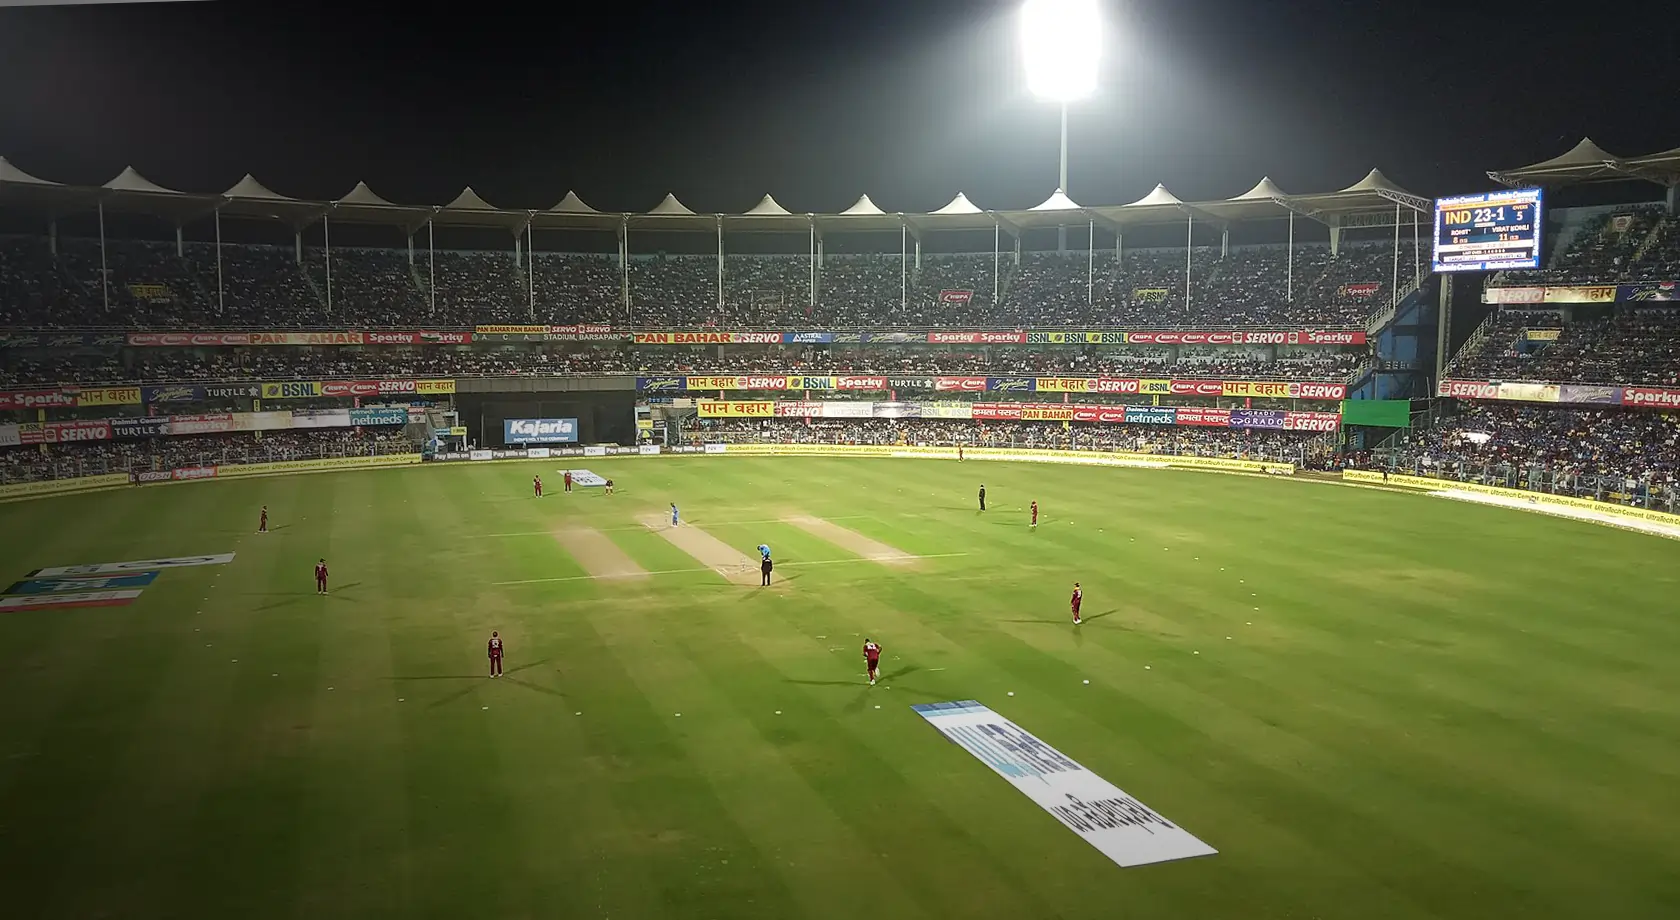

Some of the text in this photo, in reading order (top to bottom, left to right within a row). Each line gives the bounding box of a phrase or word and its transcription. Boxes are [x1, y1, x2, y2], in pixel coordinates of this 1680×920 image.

[1445, 207, 1505, 225] IND 23-1
[1516, 212, 1523, 221] 5
[249, 332, 360, 344] PAN BAHAR
[370, 333, 413, 343] Sparky
[636, 333, 731, 343] PAN BAHAR
[743, 333, 781, 342] SERVO
[935, 333, 974, 342] Sparky
[980, 333, 1020, 342] Sparky
[1028, 333, 1051, 342] BSNL
[1064, 333, 1089, 342] BSNL
[1101, 333, 1126, 343] BSNL
[1245, 333, 1284, 344] SERVO
[1308, 333, 1352, 343] Sparky
[379, 382, 415, 391] SERVO
[689, 378, 706, 388] पान
[748, 377, 785, 388] SERVO
[803, 377, 834, 389] BSNL
[838, 378, 883, 387] Sparky
[890, 379, 922, 387] TURTLE
[1038, 379, 1056, 389] पान
[1098, 381, 1138, 391] SERVO
[1149, 383, 1170, 392] BSNL
[207, 388, 244, 397] TURTLE
[282, 383, 318, 396] BSNL
[1224, 383, 1251, 394] पान
[1301, 385, 1343, 398] SERVO
[1452, 383, 1495, 397] SERVO
[80, 388, 138, 403] पान बहार
[1625, 389, 1680, 406] Sparky
[700, 402, 730, 414] पान
[783, 407, 821, 416] SERVO
[352, 413, 402, 425] netmeds
[1022, 410, 1072, 419] PAN BAHAR
[1126, 413, 1172, 424] netmeds
[510, 420, 573, 437] Kajaria
[1294, 419, 1335, 431] SERVO
[61, 427, 107, 441] SERVO
[114, 426, 155, 436] TURTLE
[1570, 500, 1592, 509] Cement
[1622, 509, 1644, 518] Cement
[1050, 792, 1175, 835] Recharge on
